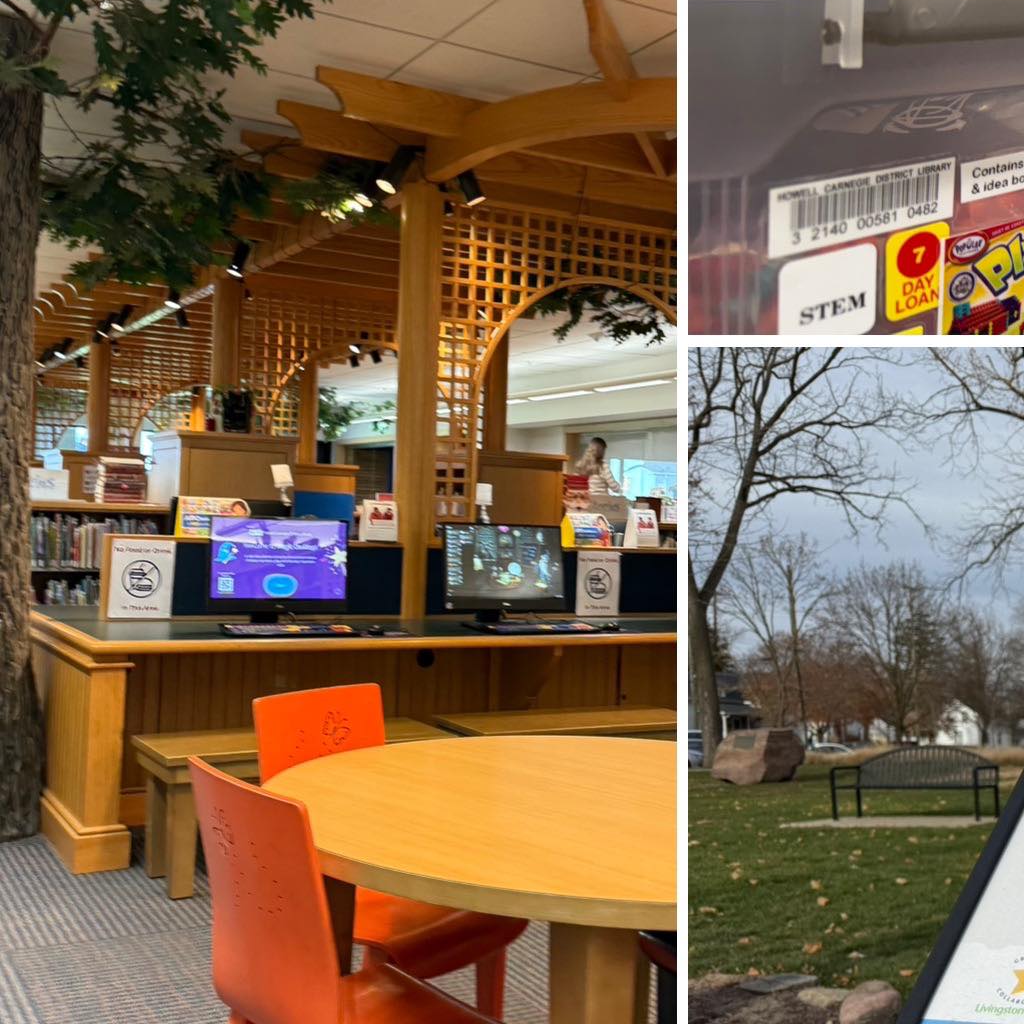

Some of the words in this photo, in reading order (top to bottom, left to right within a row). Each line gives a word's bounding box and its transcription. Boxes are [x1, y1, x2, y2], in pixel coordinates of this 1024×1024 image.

[972, 159, 1024, 179] Contains
[777, 186, 818, 203] HOWELL
[824, 176, 871, 195] CARNEGIE
[876, 168, 913, 185] DISTRICT
[917, 162, 952, 176] LIBRARY
[971, 183, 981, 195] &
[984, 177, 1009, 192] idea
[792, 232, 800, 245] 3
[811, 222, 847, 241] 2140
[857, 211, 897, 230] 00581
[907, 202, 938, 219] 0482
[913, 245, 927, 264] 7
[902, 274, 934, 297] DAY
[799, 291, 867, 326] STEM
[895, 289, 940, 315] LOAN
[974, 1003, 1024, 1017] Livingston
